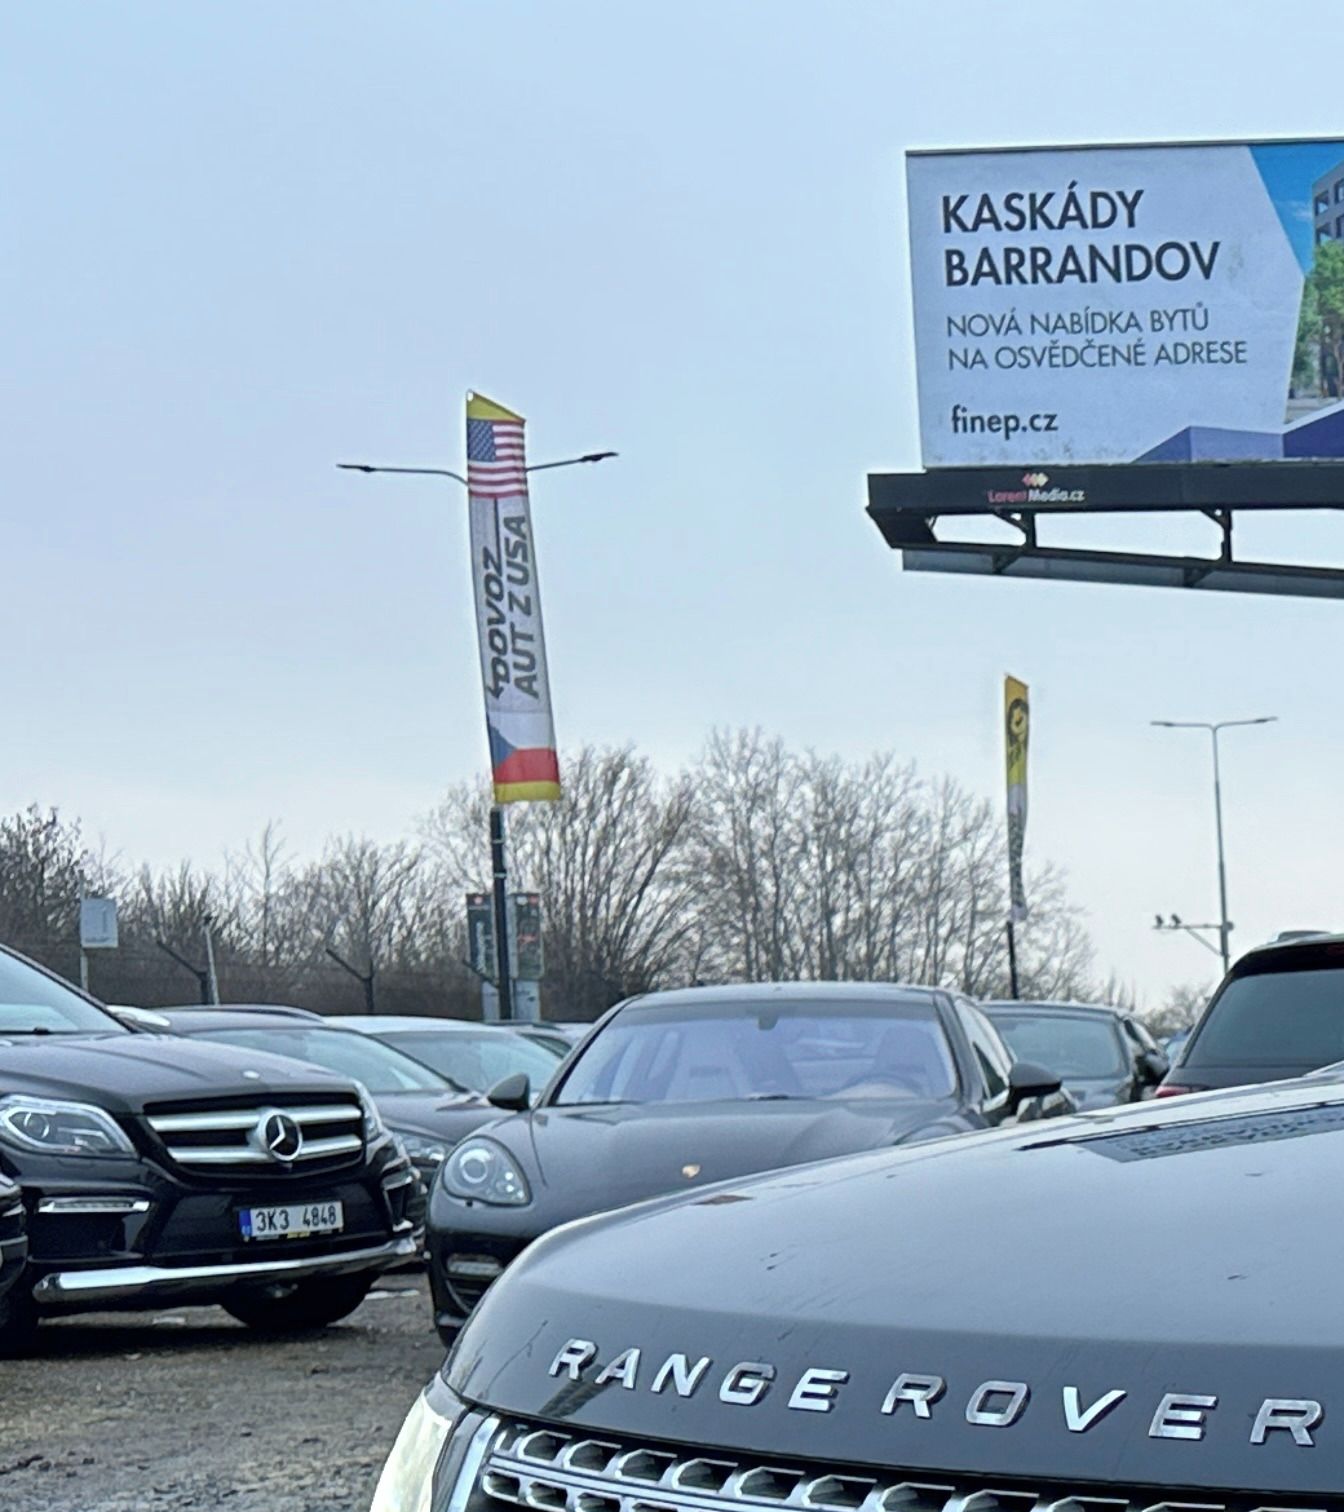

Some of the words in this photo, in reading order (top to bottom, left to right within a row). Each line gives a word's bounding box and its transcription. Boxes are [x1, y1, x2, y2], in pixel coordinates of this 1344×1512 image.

[942, 180, 1144, 233] KASKÁDY
[945, 241, 1220, 286] BARRANDOV
[947, 307, 1022, 337] NOVÁ
[1030, 306, 1143, 334] NABÍDKA
[1151, 301, 1209, 332] BYTŮ
[949, 348, 988, 370] NA
[995, 337, 1147, 369] OSVĚDČENÉ
[1154, 340, 1248, 366] ADRESE
[951, 404, 1059, 440] finep.cz
[504, 515, 530, 586] USA
[483, 546, 511, 685] DOVOZ
[508, 590, 532, 616] Z
[510, 622, 540, 699] AUT
[256, 1209, 290, 1232] 3K3
[302, 1205, 337, 1227] 4848
[548, 1339, 849, 1412] RANGE
[881, 1373, 1323, 1446] ROVER
